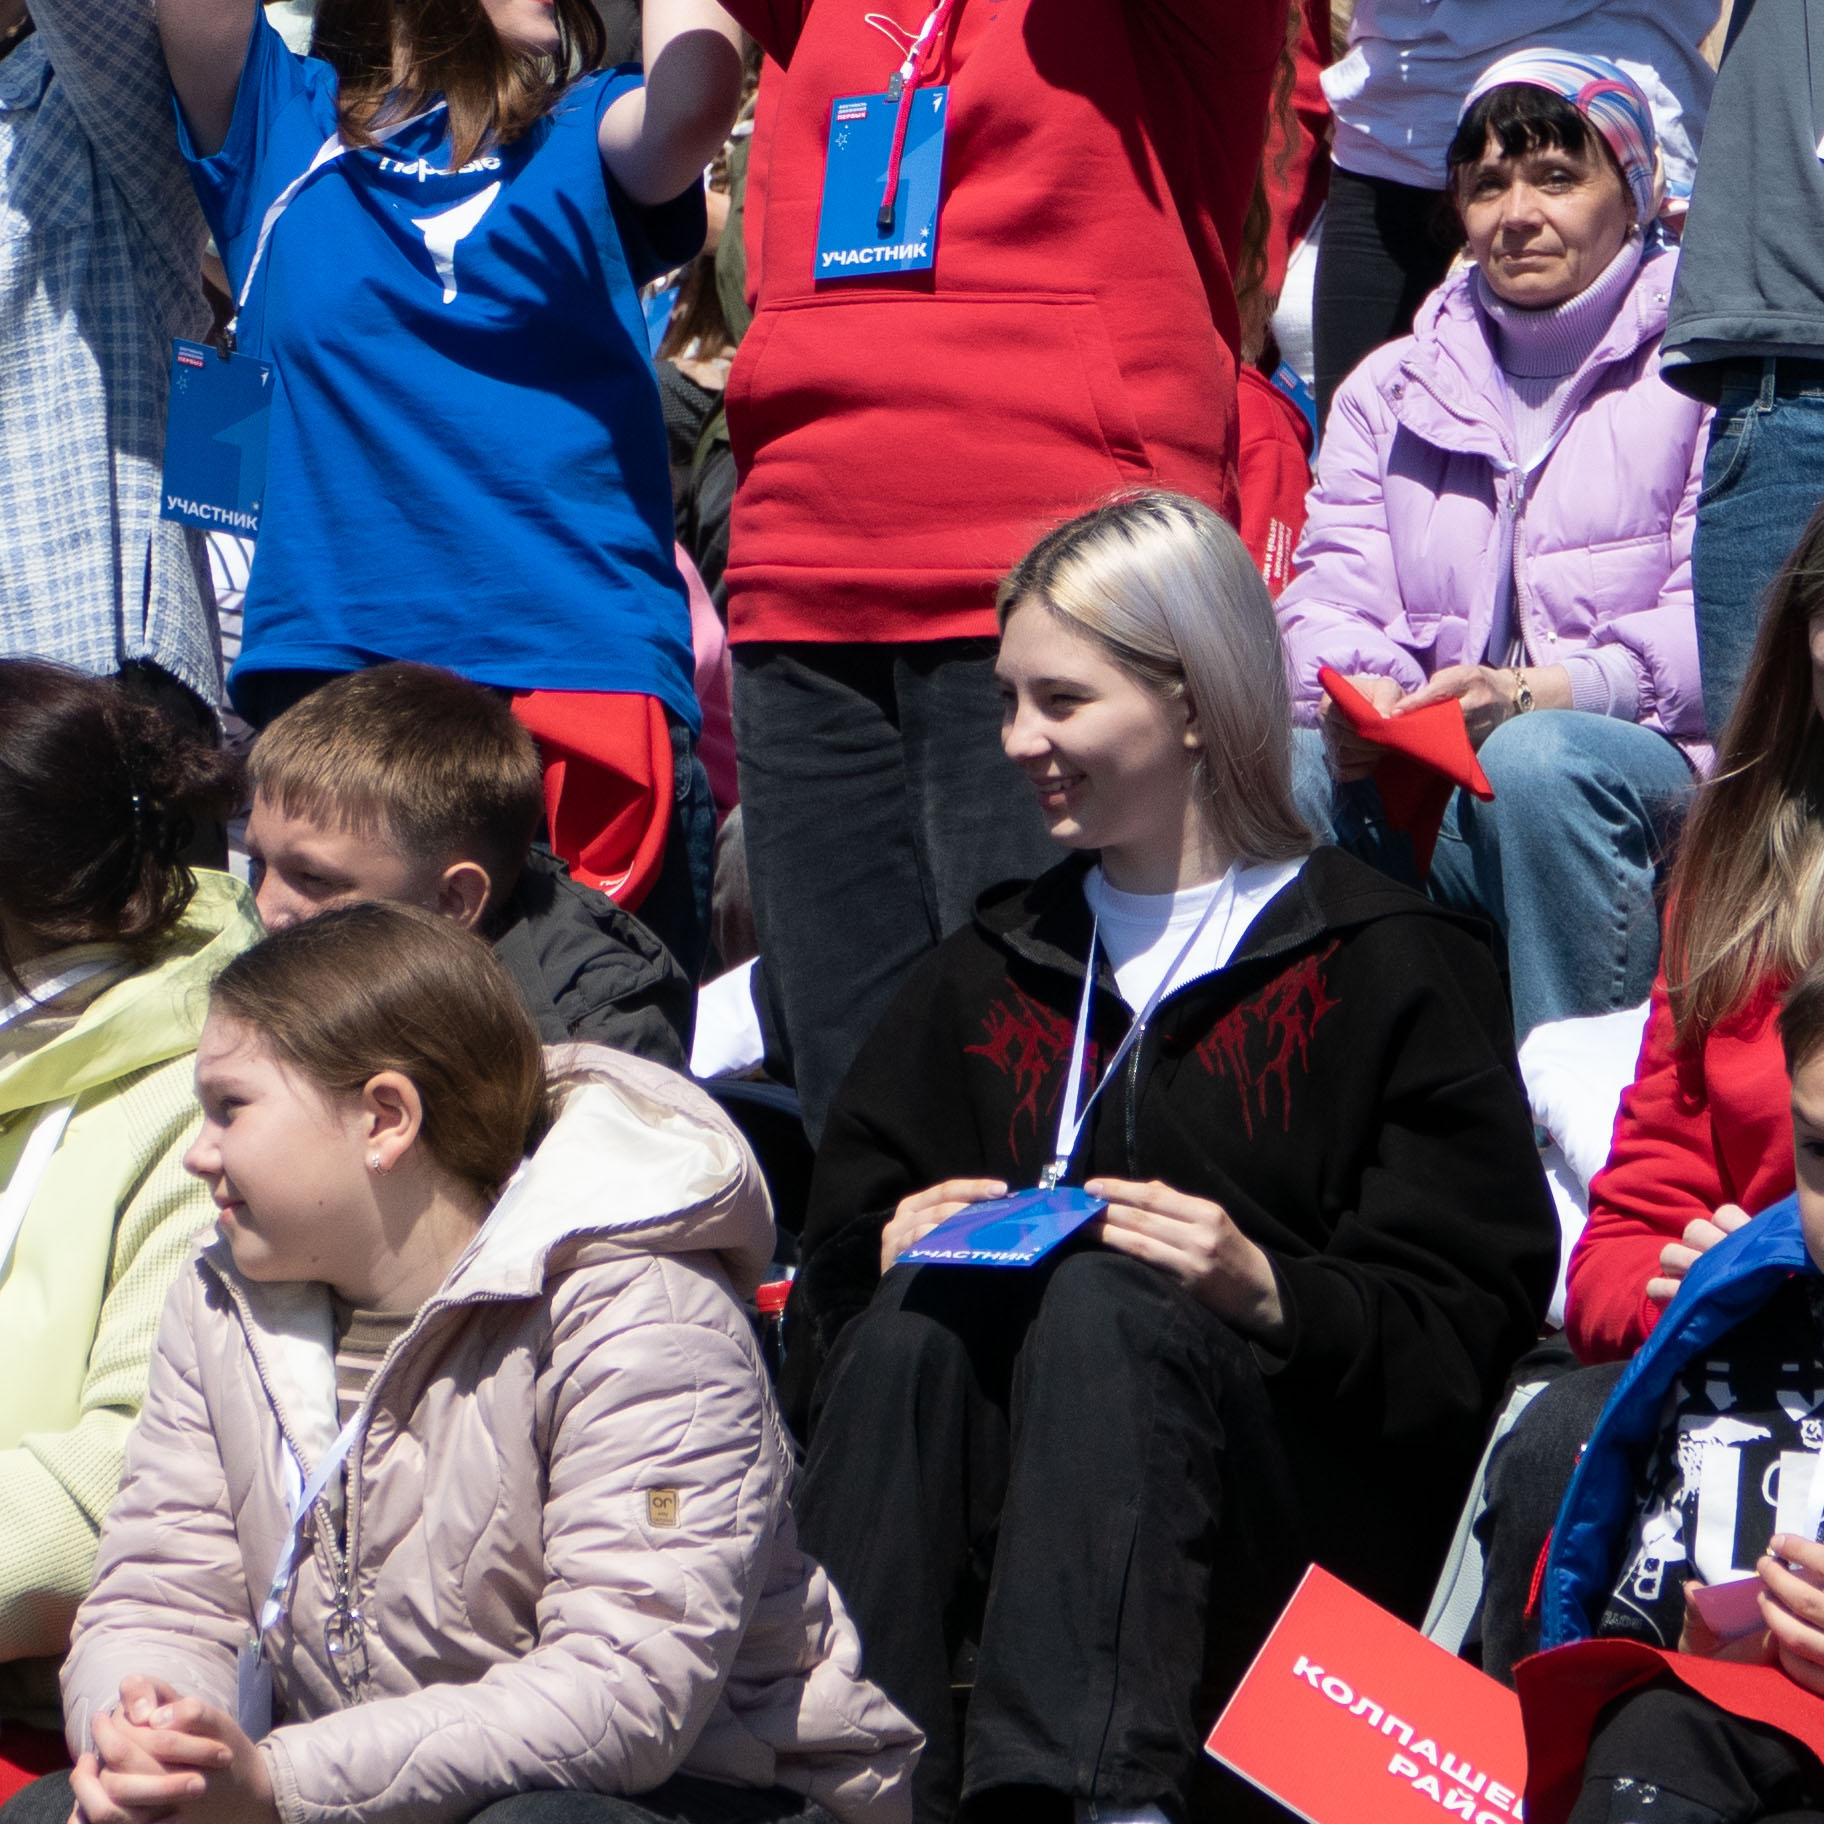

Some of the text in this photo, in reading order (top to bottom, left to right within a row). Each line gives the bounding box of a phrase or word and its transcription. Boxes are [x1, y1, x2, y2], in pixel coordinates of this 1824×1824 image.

[821, 242, 928, 268] УЧАСТНИК
[167, 494, 259, 532] УЧАСТНИК
[908, 1249, 1035, 1262] УЧАСТНИК
